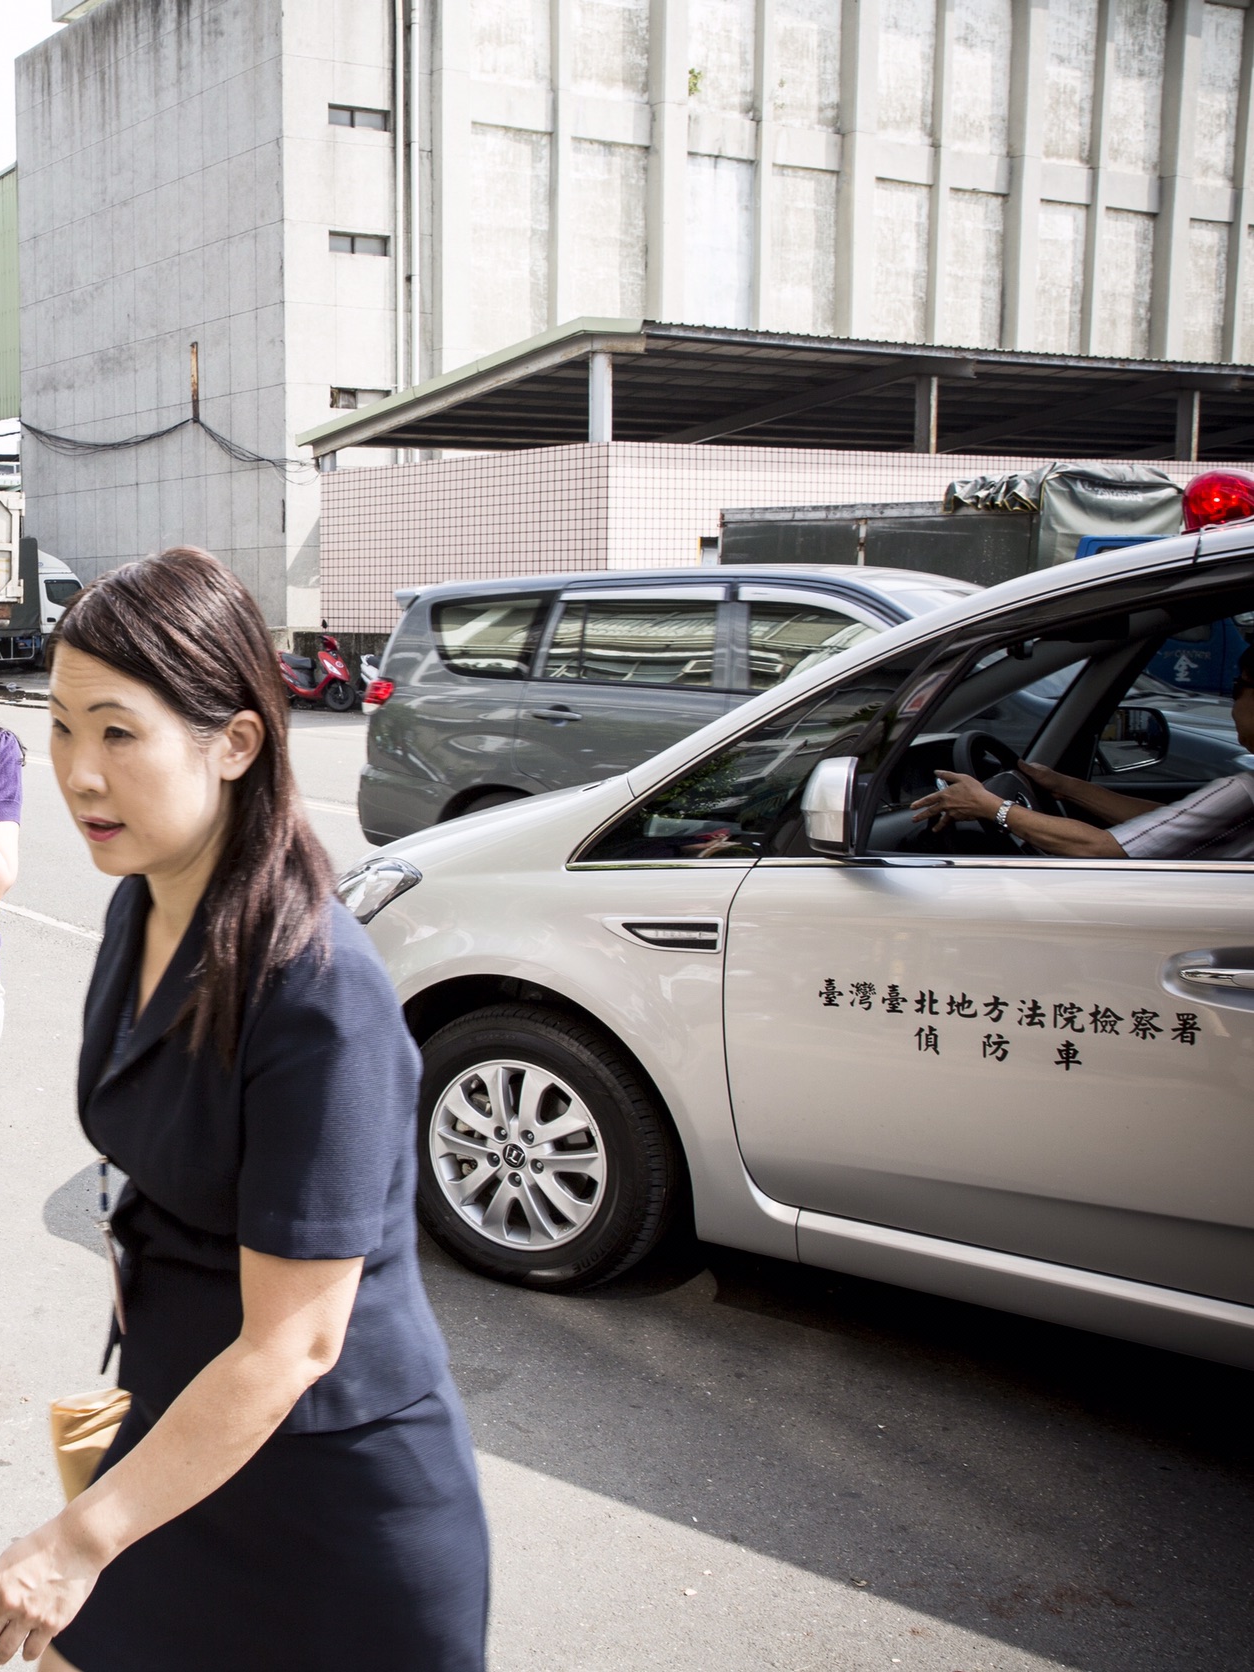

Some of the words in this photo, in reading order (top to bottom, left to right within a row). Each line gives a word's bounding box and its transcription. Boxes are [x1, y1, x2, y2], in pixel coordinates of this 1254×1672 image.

[818, 977, 1202, 1046] 臺灣臺北地方法院檢察署
